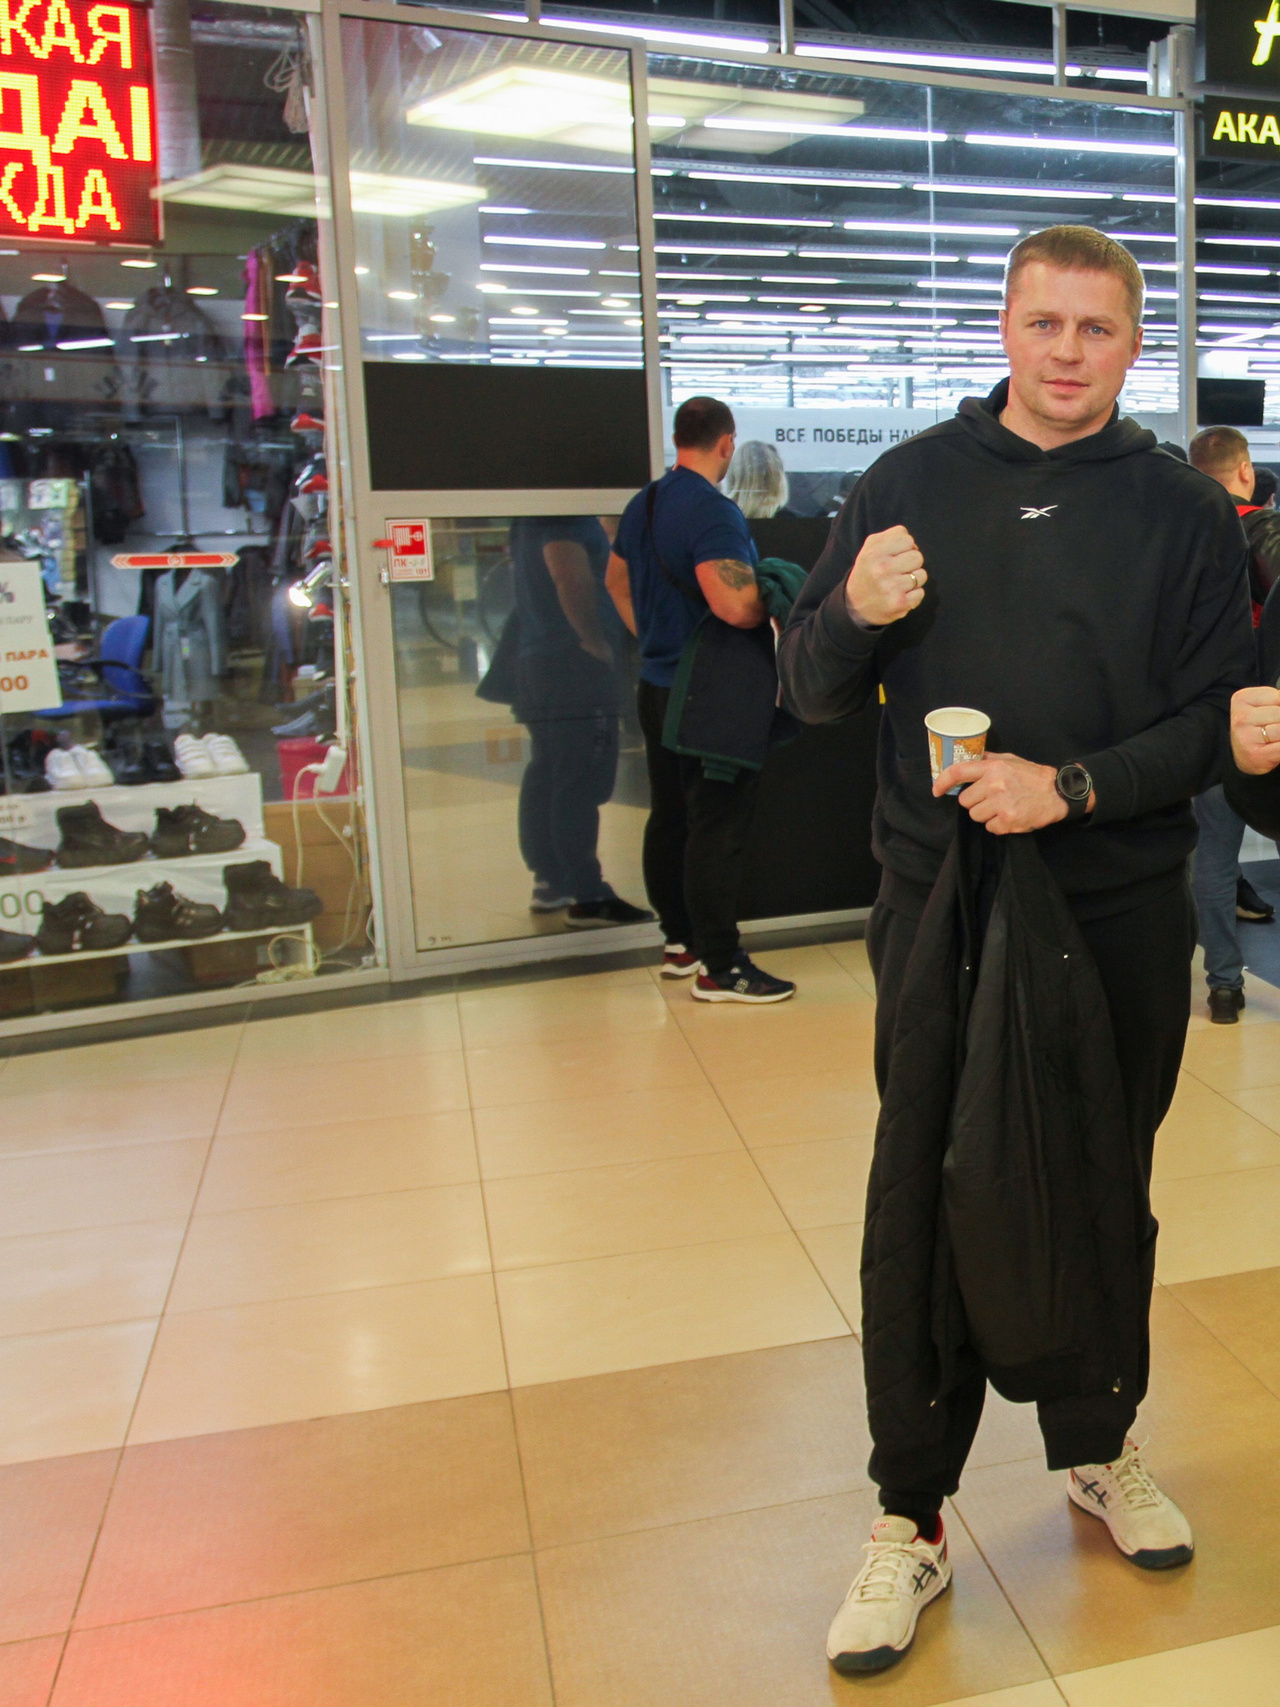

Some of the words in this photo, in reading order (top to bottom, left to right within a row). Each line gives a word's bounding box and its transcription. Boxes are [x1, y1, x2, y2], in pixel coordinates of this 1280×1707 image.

[775, 428, 806, 442] ВСЕ
[813, 428, 883, 445] ПОБЕДЫ
[5, 648, 49, 662] ПАРА
